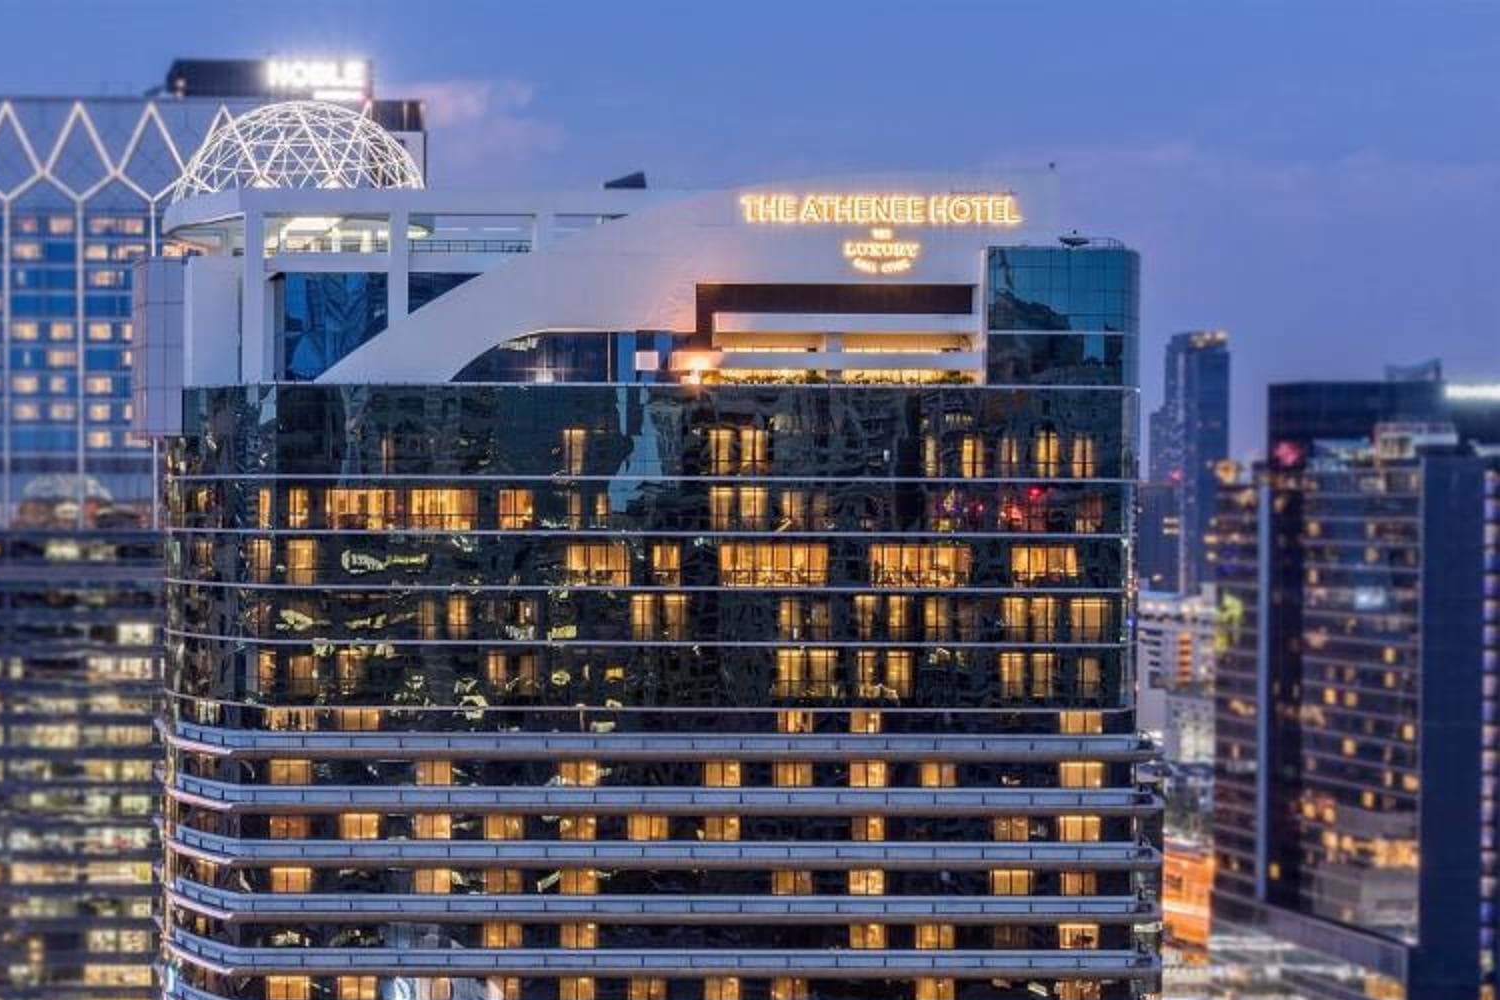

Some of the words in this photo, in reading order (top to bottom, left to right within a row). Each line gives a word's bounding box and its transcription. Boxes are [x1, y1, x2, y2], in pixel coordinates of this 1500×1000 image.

[740, 194, 799, 223] THE
[802, 194, 927, 223] ATHENEE
[929, 194, 1022, 223] HOTEL
